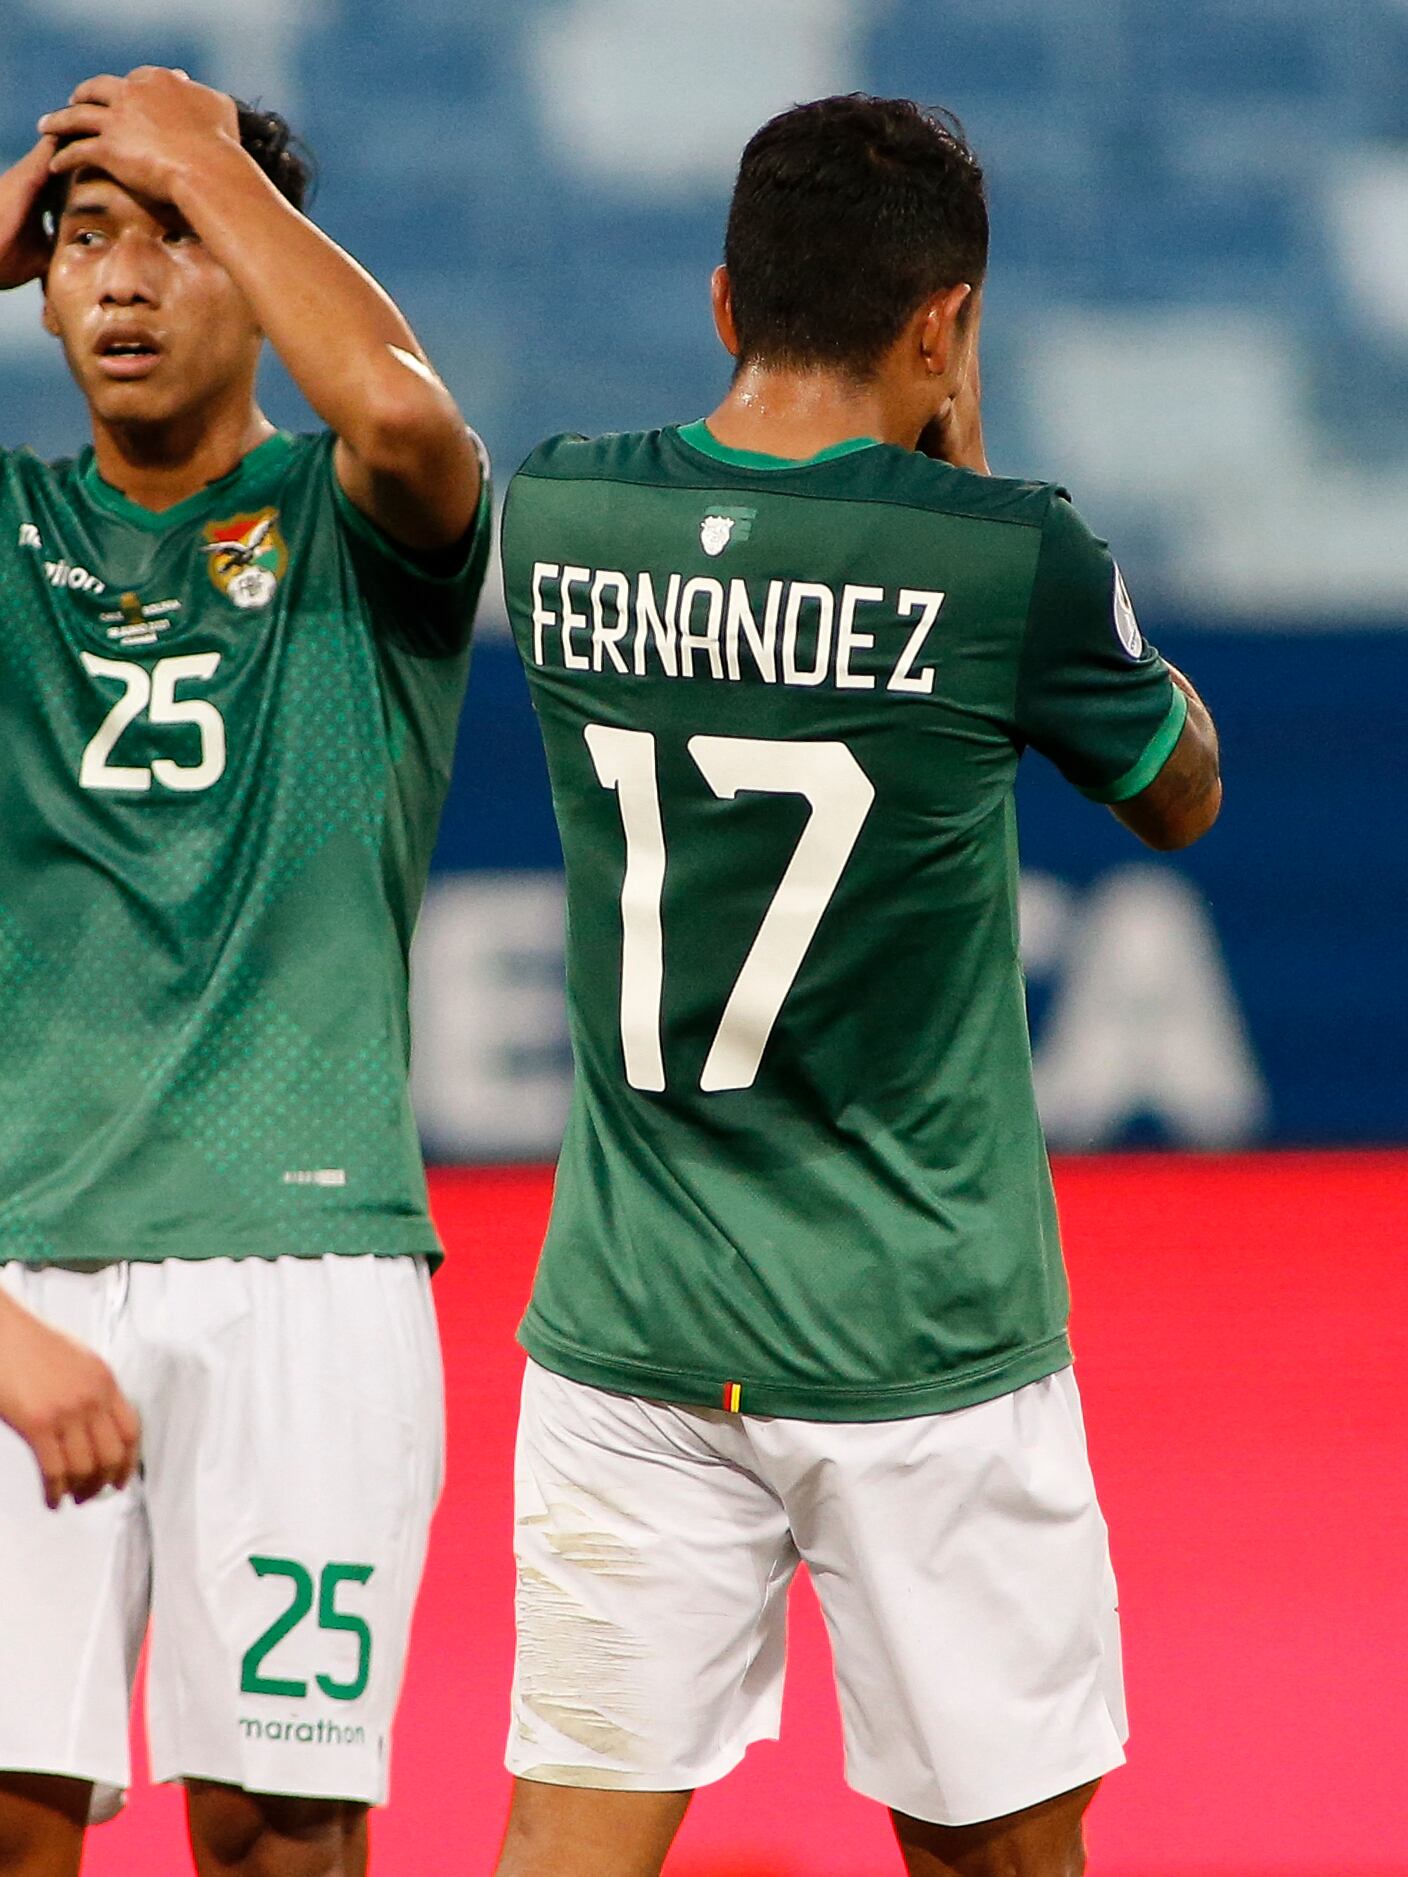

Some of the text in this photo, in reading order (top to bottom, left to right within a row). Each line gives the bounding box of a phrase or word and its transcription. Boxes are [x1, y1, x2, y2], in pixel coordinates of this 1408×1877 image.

[531, 560, 946, 694] FERNANDEZ
[78, 650, 226, 792] 25
[583, 723, 876, 1092] 17
[239, 1554, 375, 1701] 25
[239, 1718, 366, 1744] marathon
